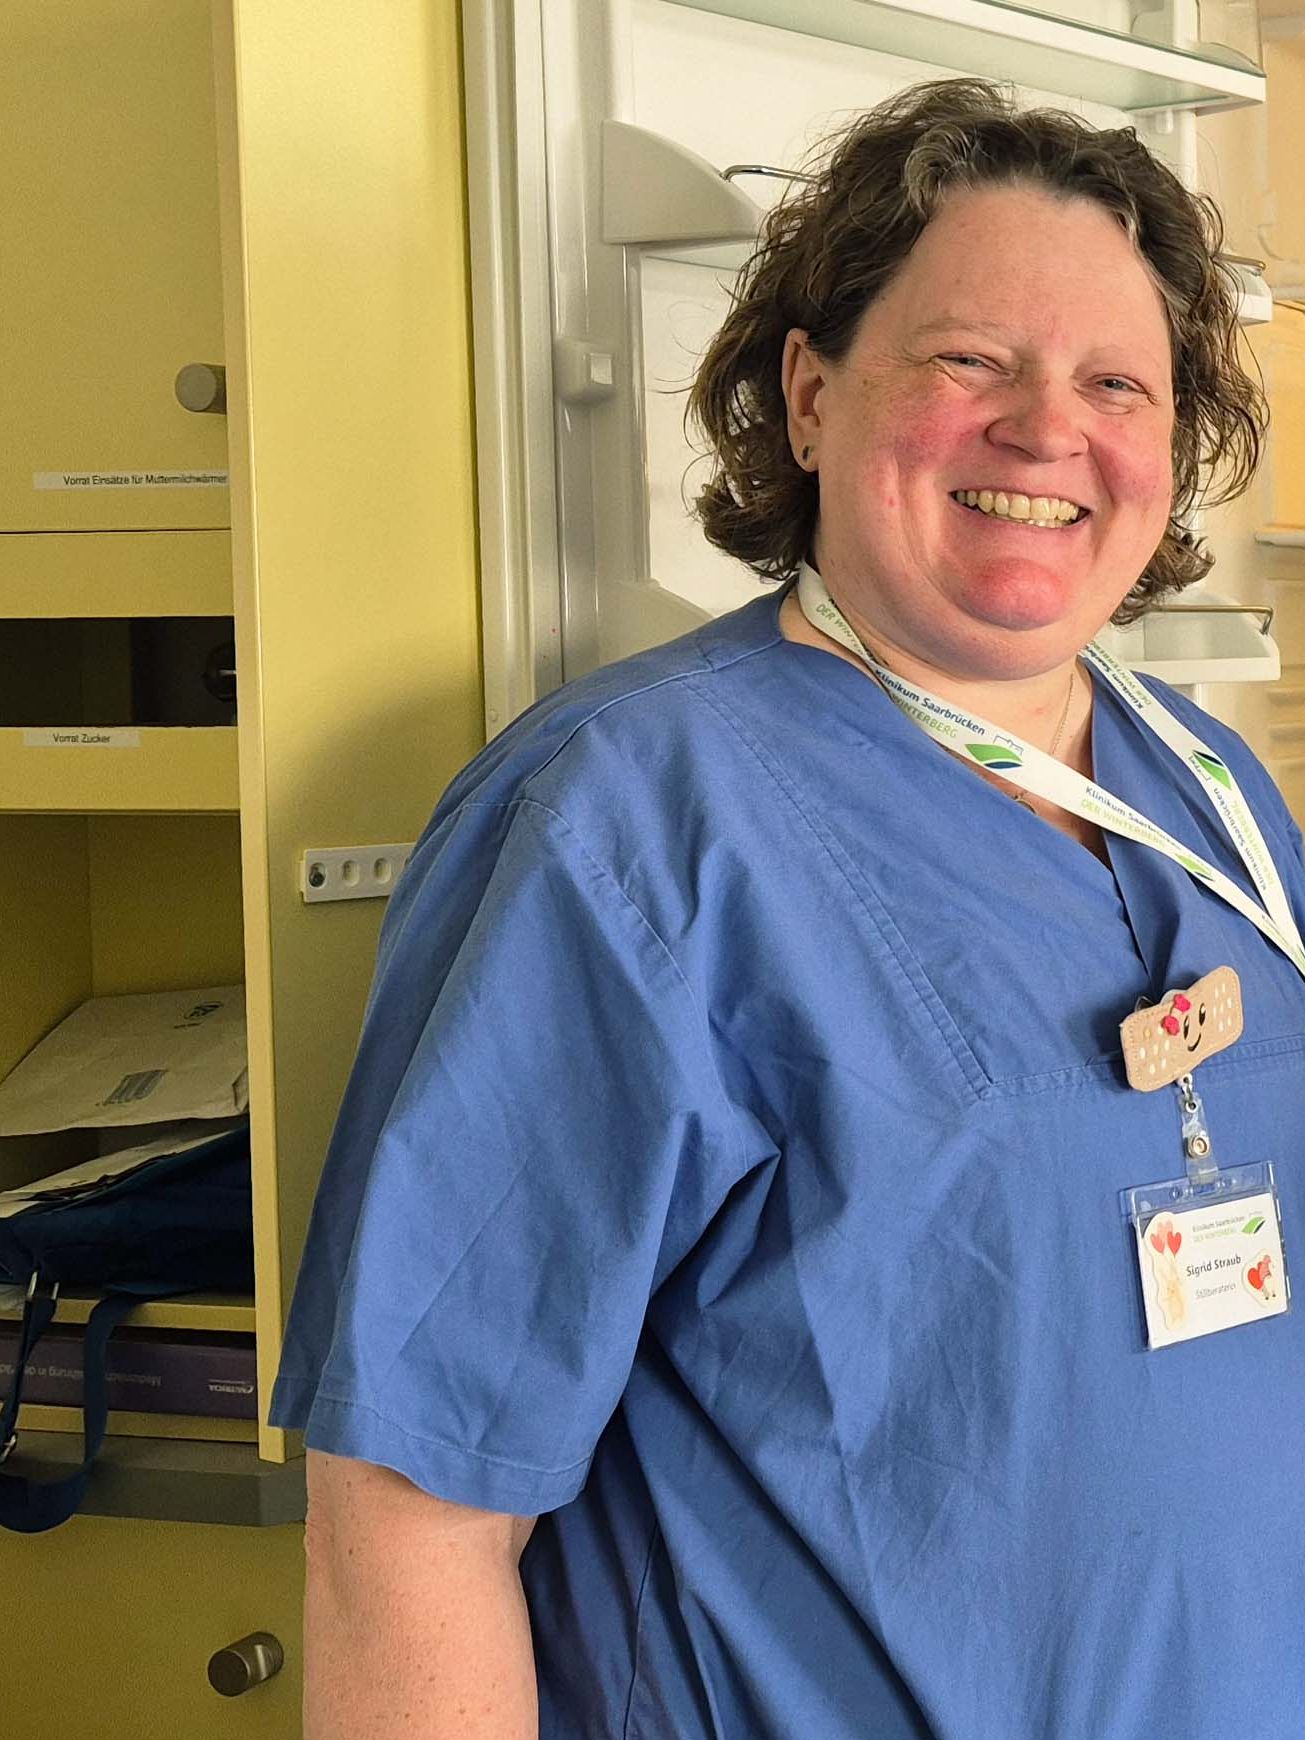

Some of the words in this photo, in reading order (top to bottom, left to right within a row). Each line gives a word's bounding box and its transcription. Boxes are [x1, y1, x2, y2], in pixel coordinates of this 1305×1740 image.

[63, 475, 90, 486] Vorrat
[92, 474, 130, 485] Einsätze
[132, 473, 144, 484] für
[876, 669, 920, 702] Klinikum
[921, 698, 985, 735] Saarbrücken
[53, 733, 79, 743] Vorrat
[81, 733, 110, 743] Zucker
[1085, 786, 1125, 816] Klinikum
[1186, 1261, 1212, 1278] Sigrid
[1214, 1253, 1242, 1269] Straub
